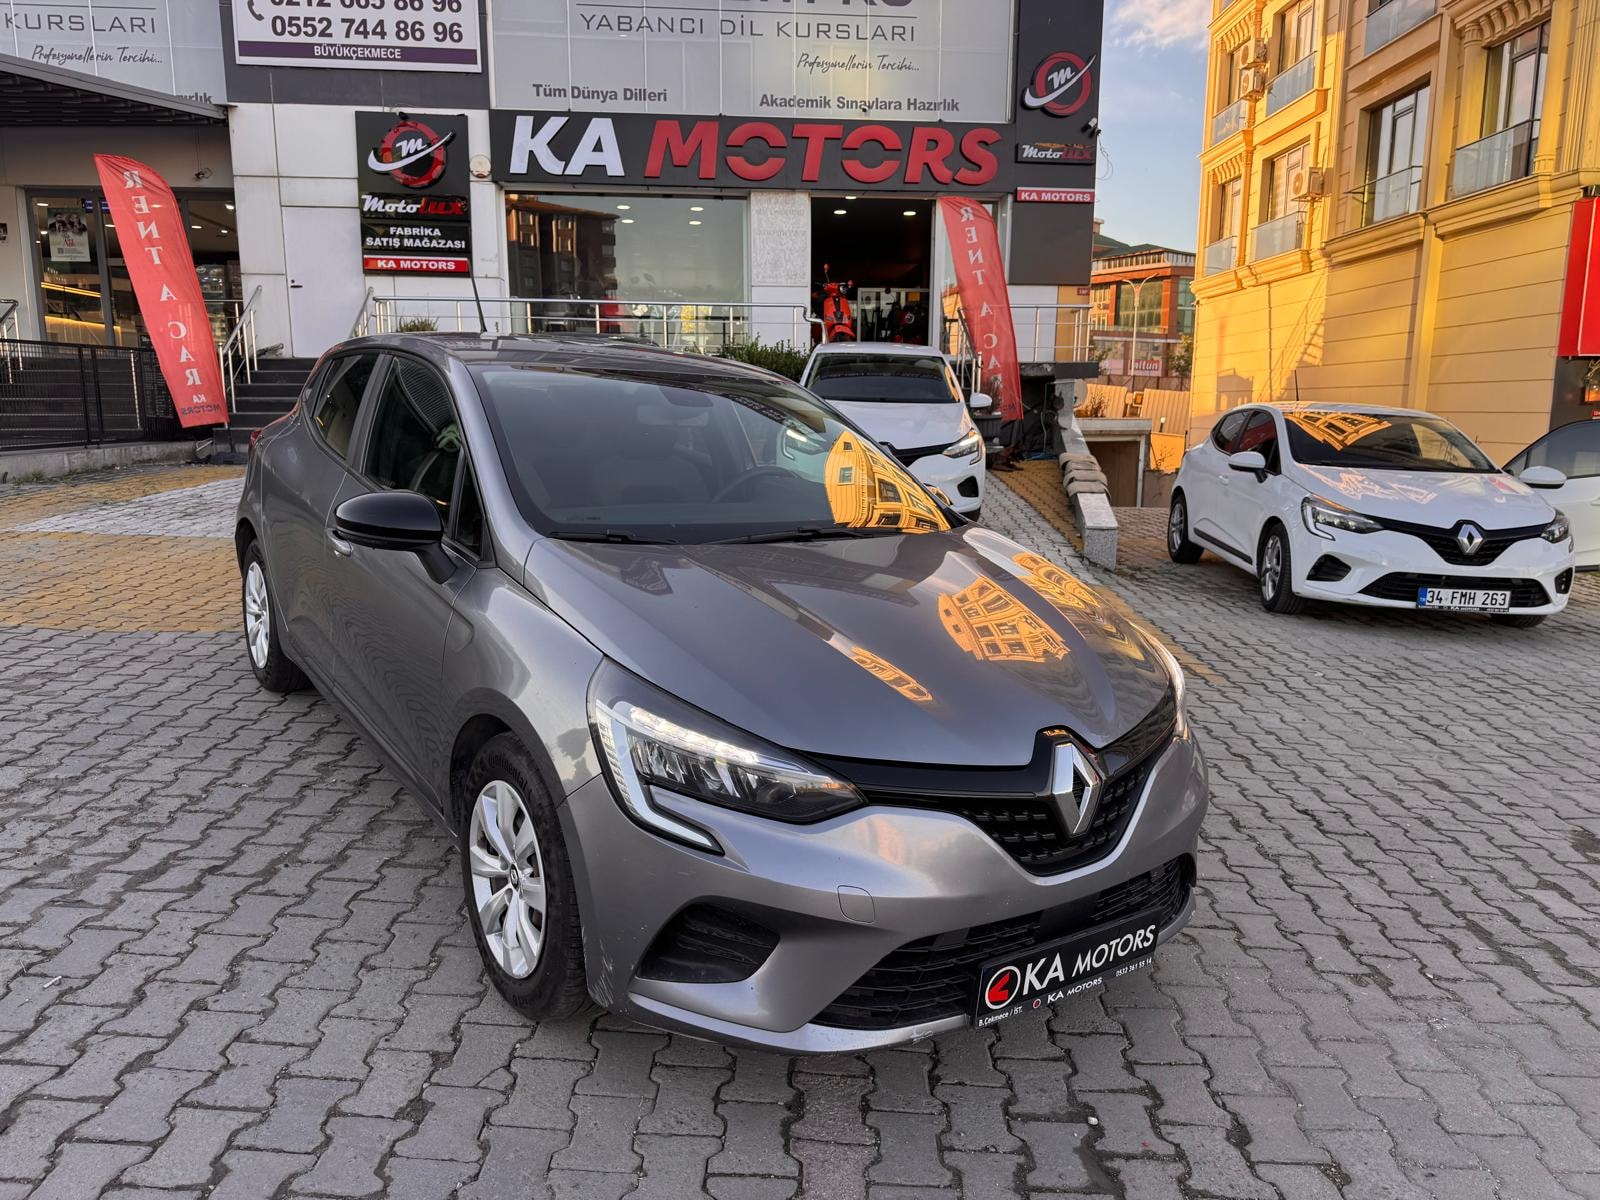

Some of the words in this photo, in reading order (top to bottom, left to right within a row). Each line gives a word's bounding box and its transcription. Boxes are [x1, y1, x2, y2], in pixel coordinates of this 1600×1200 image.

[4, 13, 156, 34] KURSLARI
[271, 15, 333, 38] 0552
[341, 18, 387, 40] 744
[395, 20, 425, 42] 86
[432, 21, 464, 43] 96
[580, 13, 704, 35] YABANCI
[720, 14, 764, 37] DİL
[776, 20, 915, 42] KURSLARI
[32, 44, 113, 66] Profesyonellerin
[313, 43, 402, 60] BÜYÜKÇEKMECE
[797, 52, 873, 75] Profesyonellerin
[532, 83, 567, 98] Tüm
[571, 85, 618, 104] Dünya
[623, 87, 667, 102] Dilleri
[759, 93, 832, 109] Akademik
[836, 95, 902, 111] Sınavlara
[906, 97, 960, 112] Hazırlık
[509, 115, 625, 177] KA
[644, 119, 1002, 186] MOTORS
[1021, 191, 1038, 200] KA
[1041, 192, 1091, 201] MOTORS
[389, 225, 442, 237] FABRİKA
[365, 236, 401, 249] SATIŞ
[403, 236, 466, 249] MAĞAZASI
[377, 259, 396, 269] KA
[400, 260, 456, 270] MOTORS
[1427, 590, 1443, 604] 34
[1450, 590, 1477, 605] FMH
[1482, 592, 1507, 607] 263
[1022, 952, 1065, 996] KA
[1071, 924, 1156, 978] MOTORS
[1047, 990, 1064, 1004] KA
[1066, 977, 1103, 997] MOTORS
